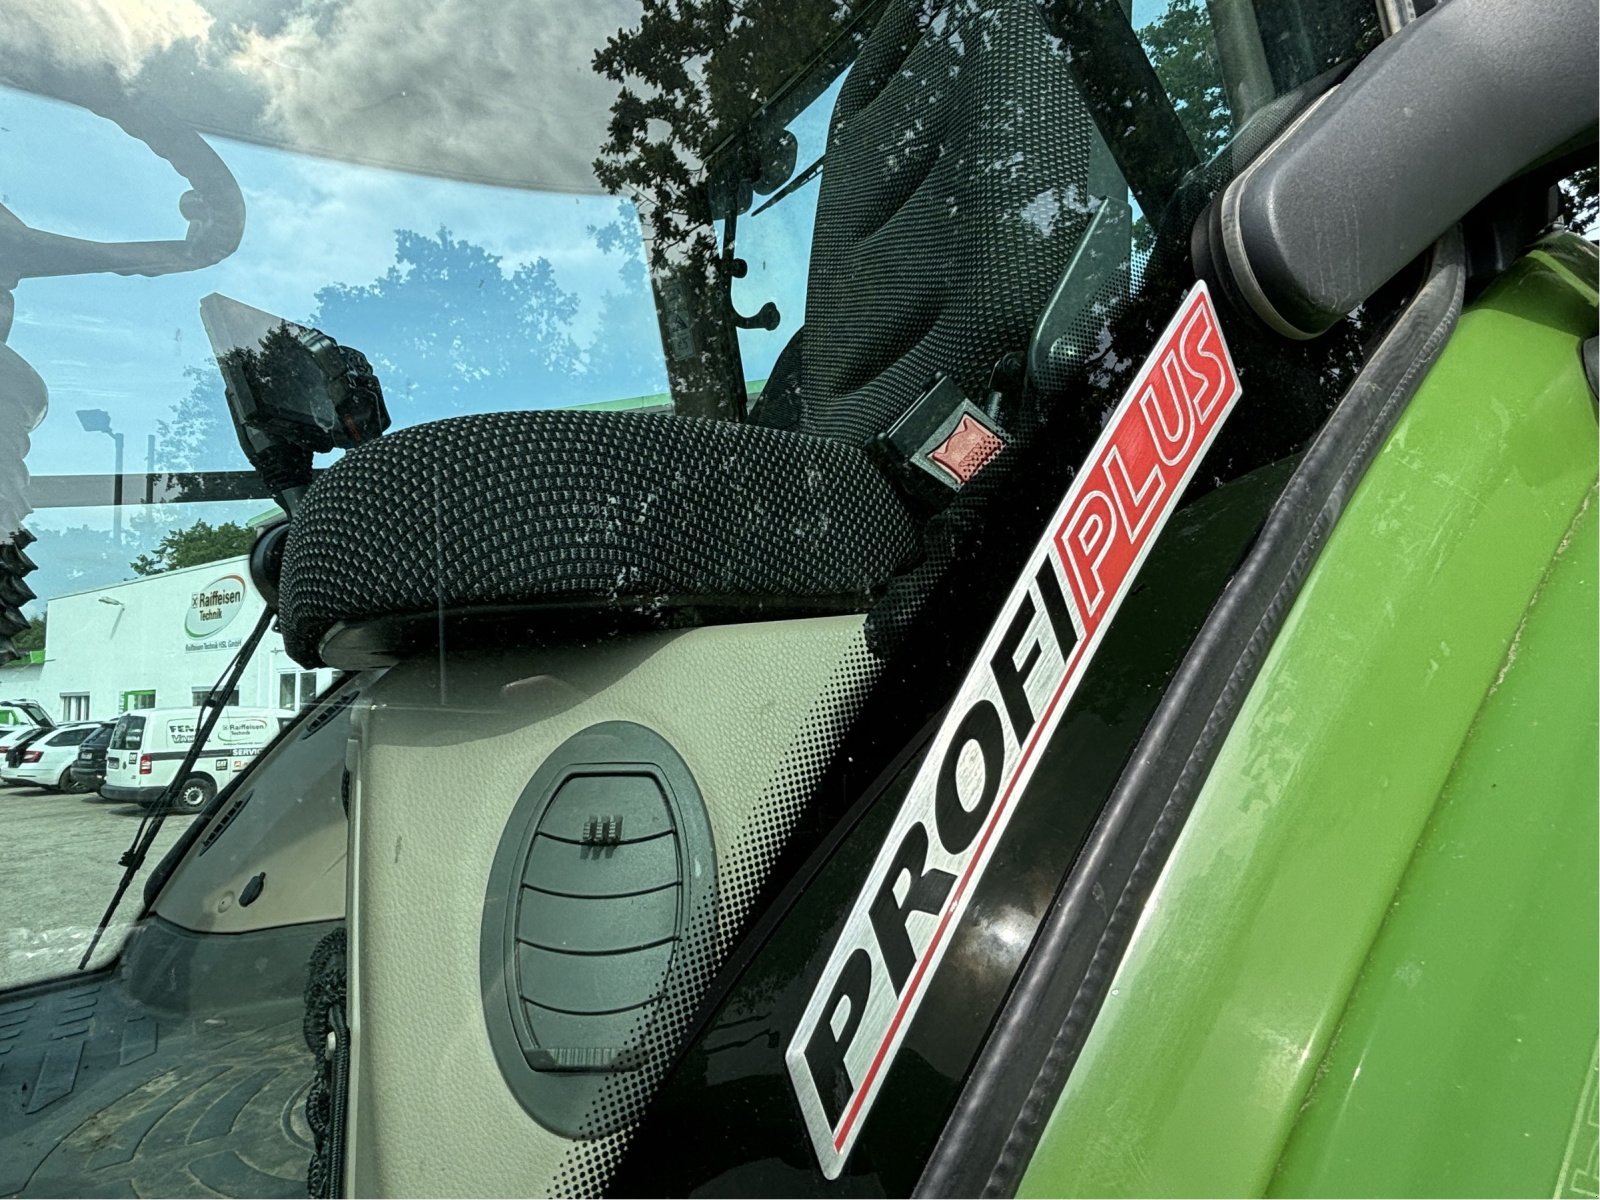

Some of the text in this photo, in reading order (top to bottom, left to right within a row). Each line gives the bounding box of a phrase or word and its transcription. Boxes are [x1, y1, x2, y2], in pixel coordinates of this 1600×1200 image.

[199, 590, 241, 608] Raiffeisen
[199, 608, 222, 621] Technik
[232, 748, 263, 756] SERVIC
